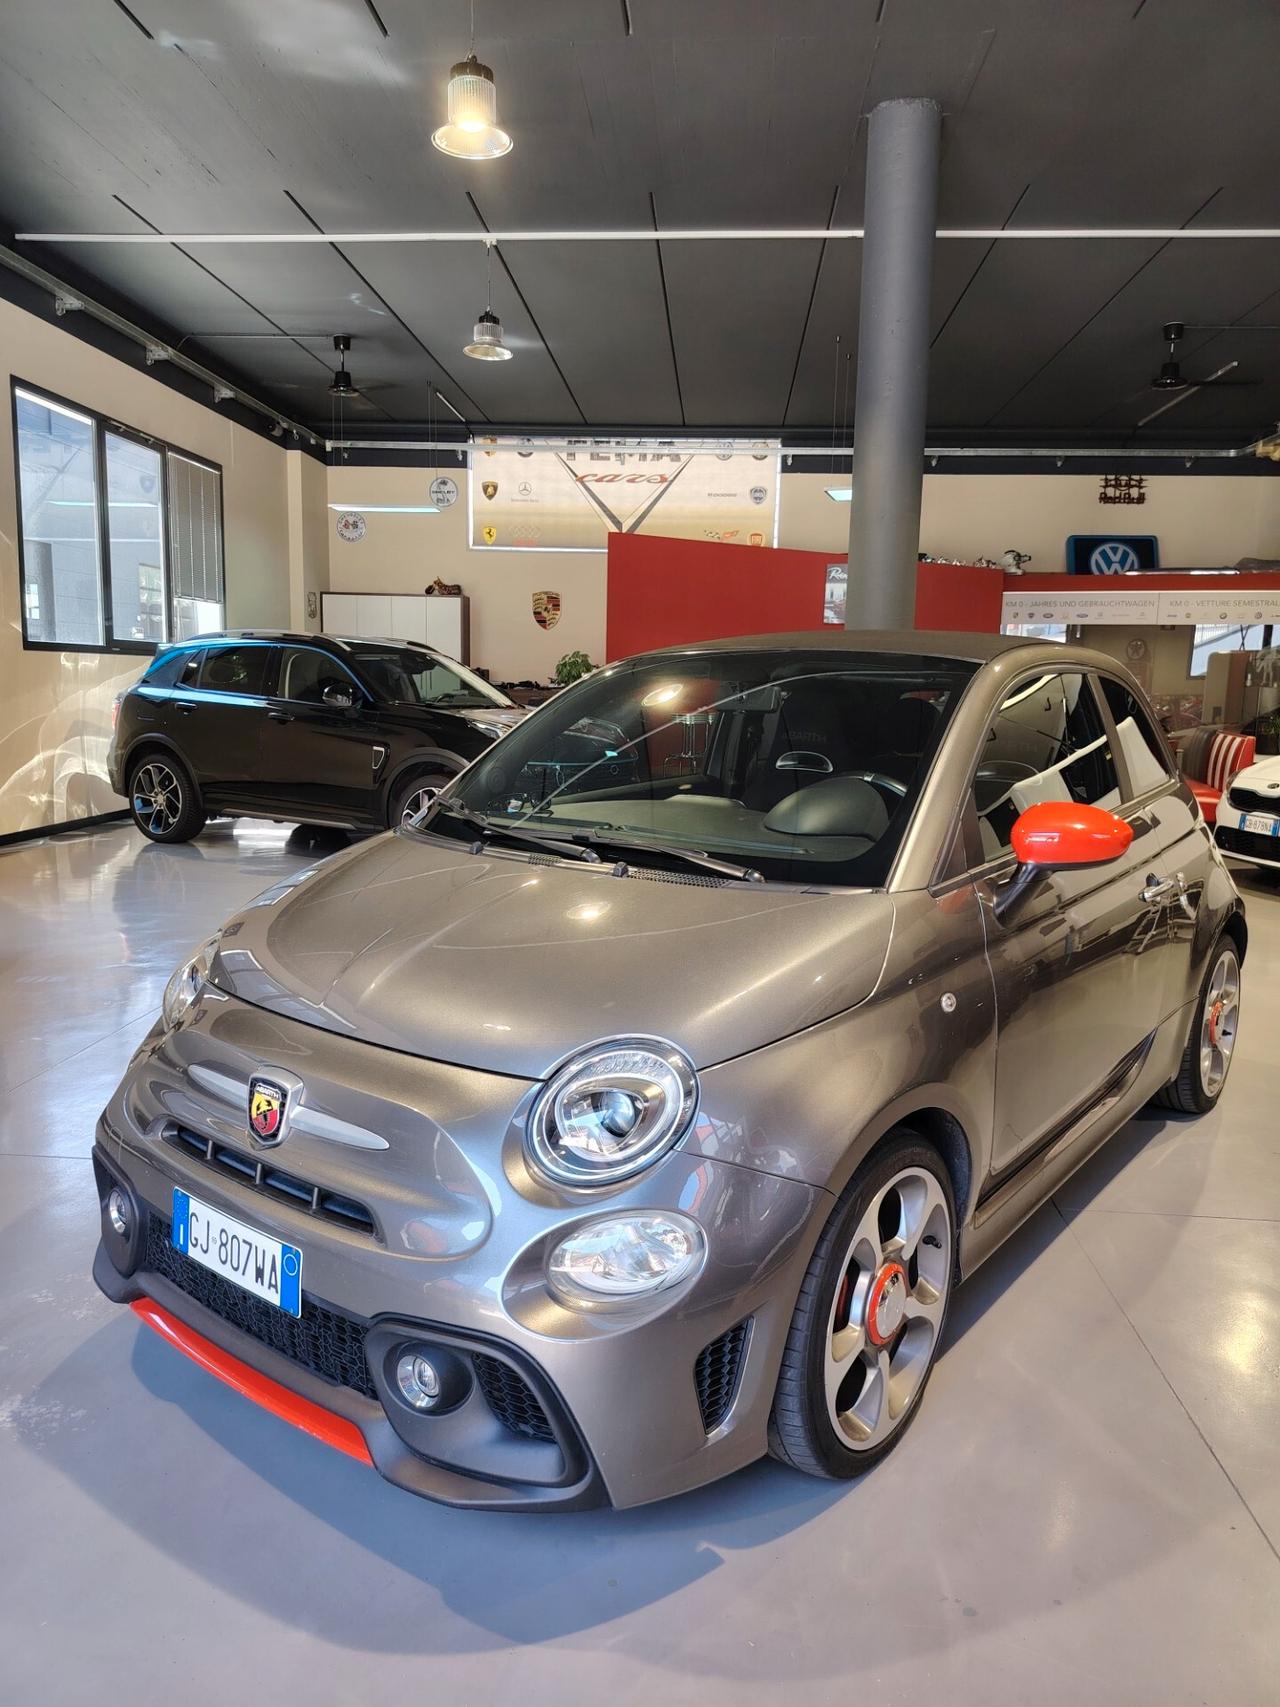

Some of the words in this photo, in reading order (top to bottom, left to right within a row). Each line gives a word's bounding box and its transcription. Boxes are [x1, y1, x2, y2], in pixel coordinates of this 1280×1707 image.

[1029, 599, 1057, 608] JAHRES
[1059, 599, 1076, 608] UND
[1078, 599, 1155, 608] GEBRAUCHTWAGEN
[189, 1212, 211, 1254] GJ
[218, 1227, 280, 1295] 807WA
